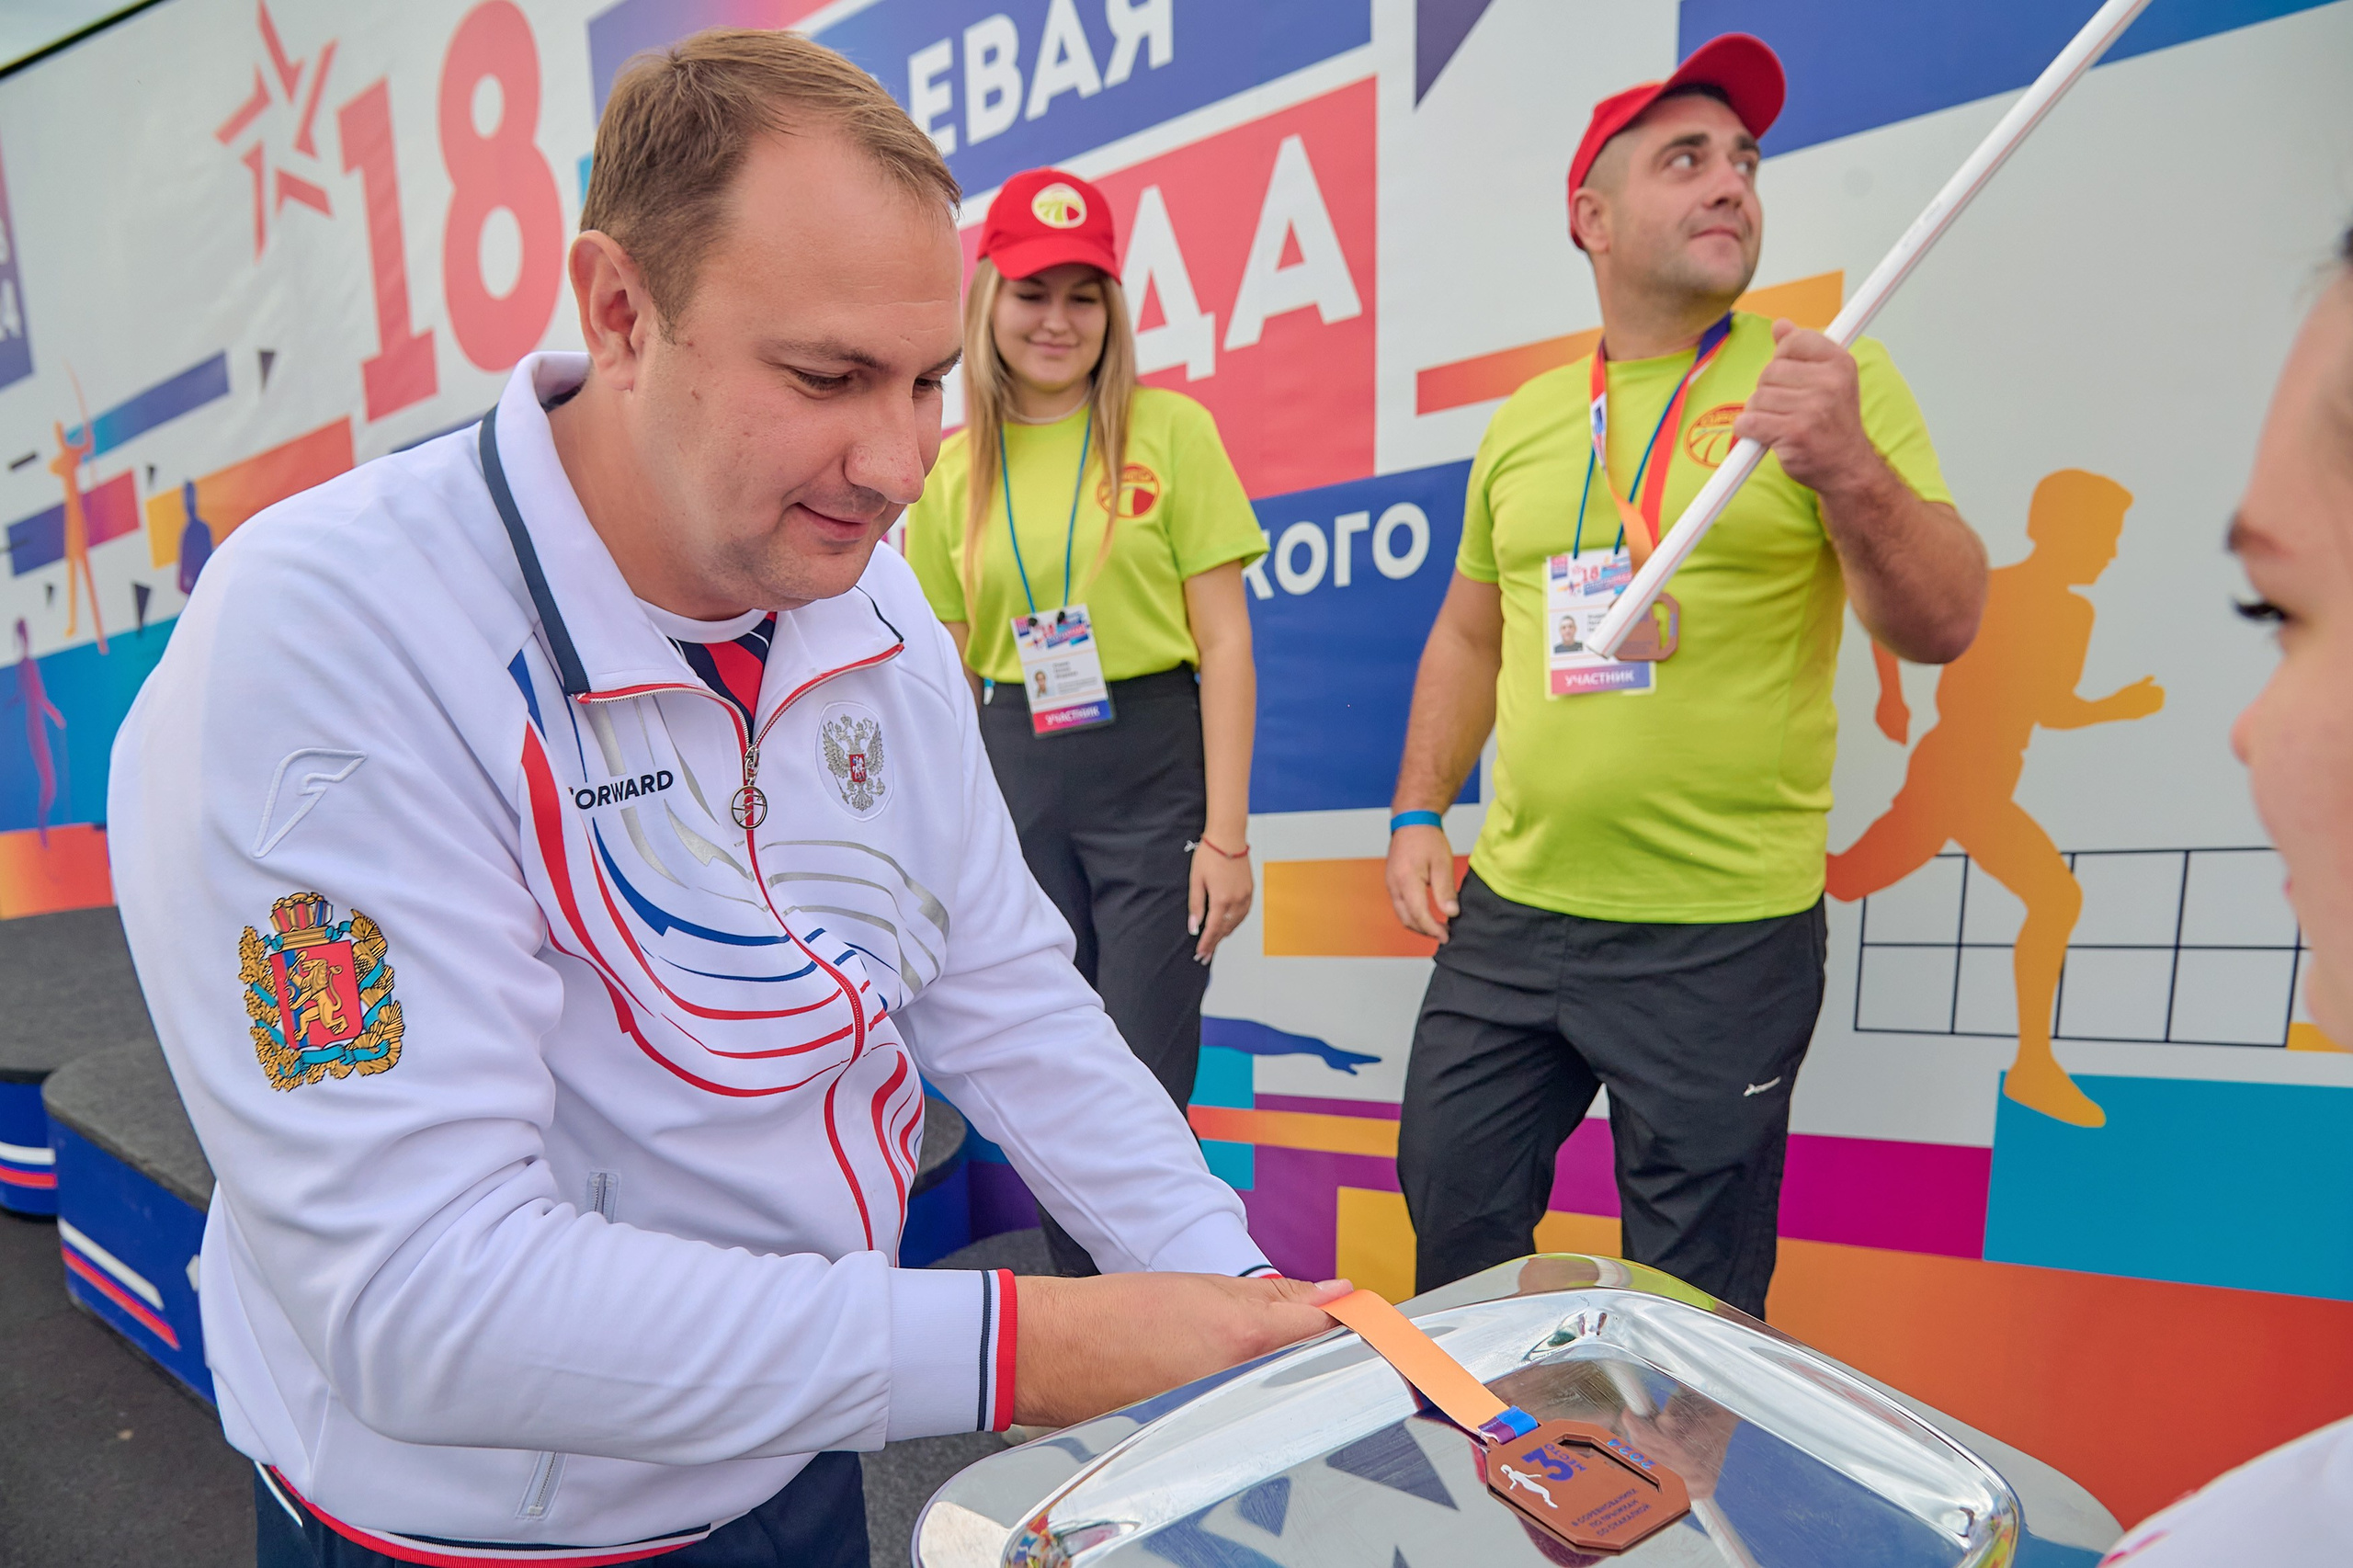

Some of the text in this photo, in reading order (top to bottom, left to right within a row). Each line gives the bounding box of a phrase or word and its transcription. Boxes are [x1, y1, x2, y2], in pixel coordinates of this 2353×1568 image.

[336, 0, 564, 425] 18
[1564, 669, 1635, 687] УЧАСТНИК
[1521, 1447, 1574, 1482] 3
[1607, 1438, 1656, 1470] 2024
